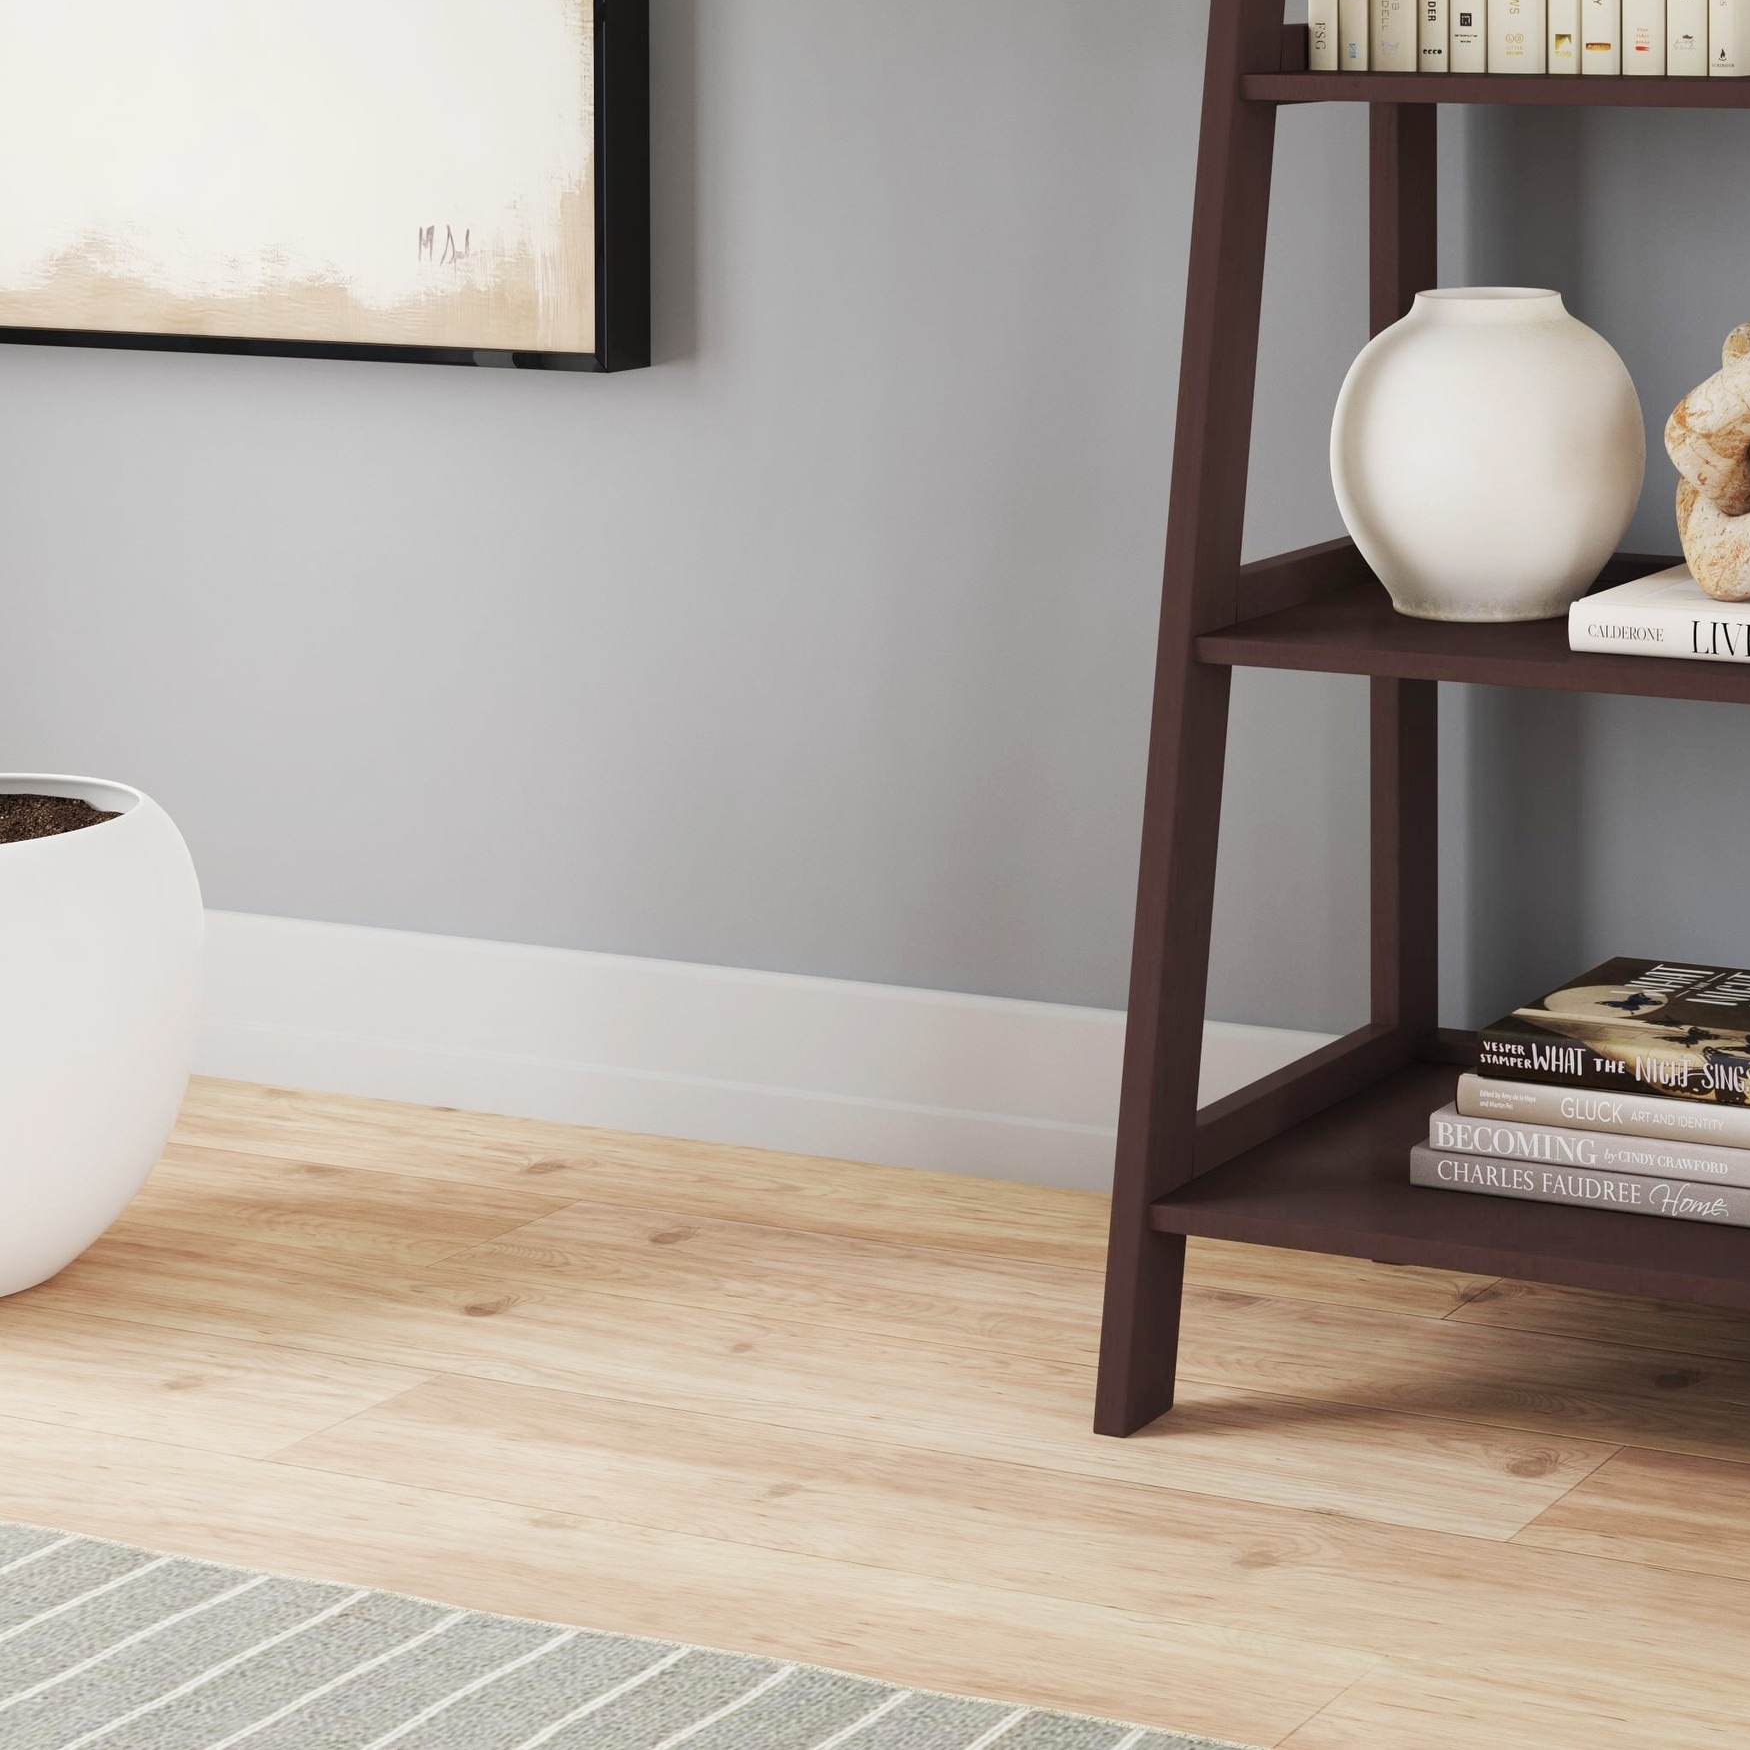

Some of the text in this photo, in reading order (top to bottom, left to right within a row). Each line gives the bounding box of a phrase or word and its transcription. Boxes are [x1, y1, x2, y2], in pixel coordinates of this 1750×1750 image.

[1314, 22, 1326, 50] FSG
[1587, 624, 1664, 643] CALDERONE
[1610, 964, 1715, 997] WHAT
[1480, 1053, 1532, 1070] STAMPER
[1482, 1040, 1525, 1056] VESPER
[1531, 1043, 1586, 1076] WHAT
[1593, 1058, 1626, 1074] THE
[1635, 1055, 1692, 1087] NIGHT
[1561, 1097, 1724, 1131] GLUCK ART AND IDENTITY
[1435, 1121, 1728, 1175] BECOMING by CINDY CRAWFORD
[1437, 1159, 1729, 1217] CHARLES FAUDREE Home
